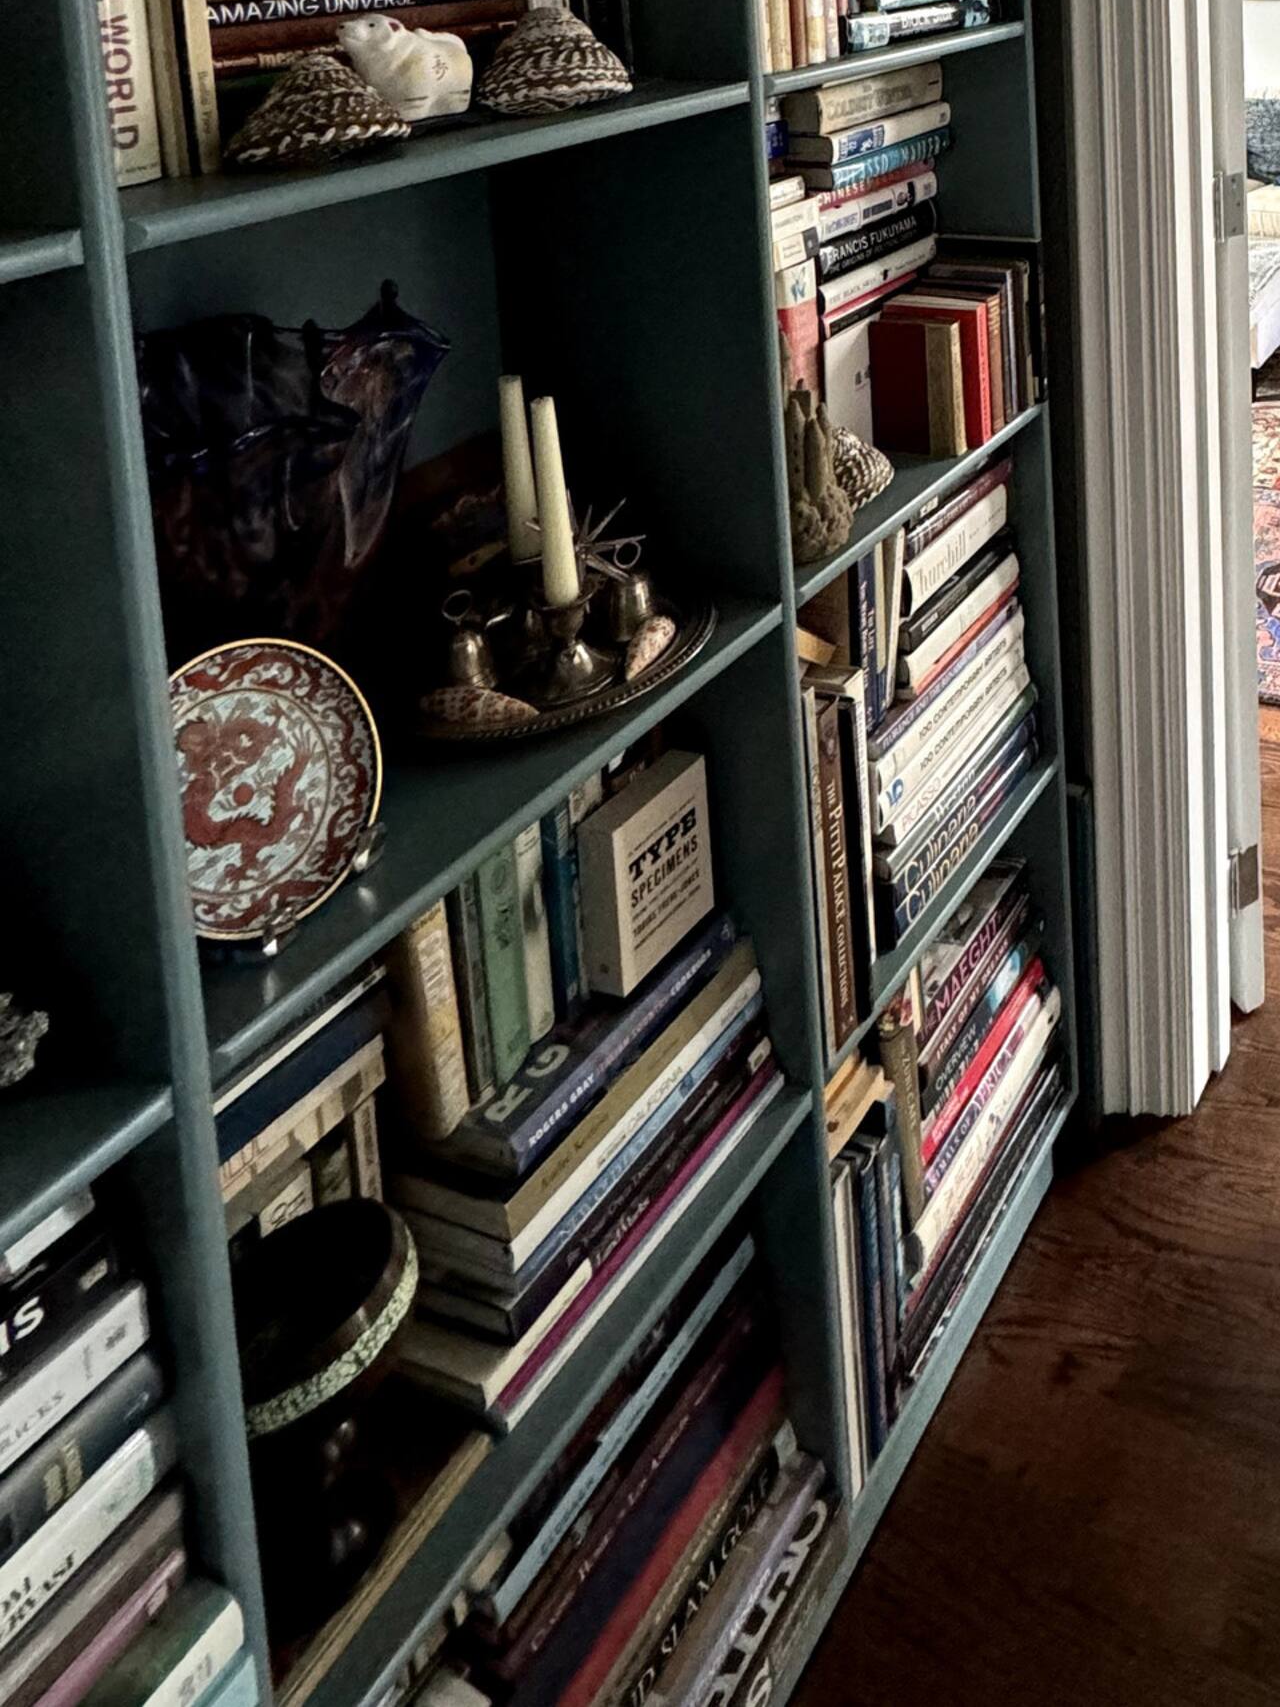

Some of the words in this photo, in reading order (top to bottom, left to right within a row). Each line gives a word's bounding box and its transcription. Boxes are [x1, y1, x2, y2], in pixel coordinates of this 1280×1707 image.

[104, 13, 140, 152] WORLD
[817, 181, 867, 208] CHINESE
[826, 237, 870, 266] FRANCIS
[870, 214, 918, 245] FUKUYAMA
[917, 720, 935, 740] 100
[931, 662, 985, 725] CONTEMPORARY
[982, 635, 1009, 668] ARTISTS
[917, 750, 935, 771] 100
[931, 692, 986, 755] CONTEMPORARY
[982, 665, 1010, 696] ARTISTS
[825, 782, 836, 805] THE
[827, 802, 845, 853] PITTI
[629, 806, 696, 883] TYPE
[631, 834, 698, 908] SPECIMENS
[903, 795, 977, 895] Culinaria
[904, 822, 981, 925] Culinaria
[831, 851, 848, 924] PALACE
[835, 924, 849, 1007] COLLECTIONS
[933, 914, 1000, 1015] MAEGHT
[934, 1022, 960, 1060] ITALY
[935, 1024, 978, 1091] OVERVIEW
[526, 1100, 569, 1148] ROGERS
[566, 1070, 598, 1105] GRAY
[925, 1137, 960, 1195] ANIMALS
[970, 1043, 1013, 1121] AFRICA
[658, 1558, 723, 1658] SLAM
